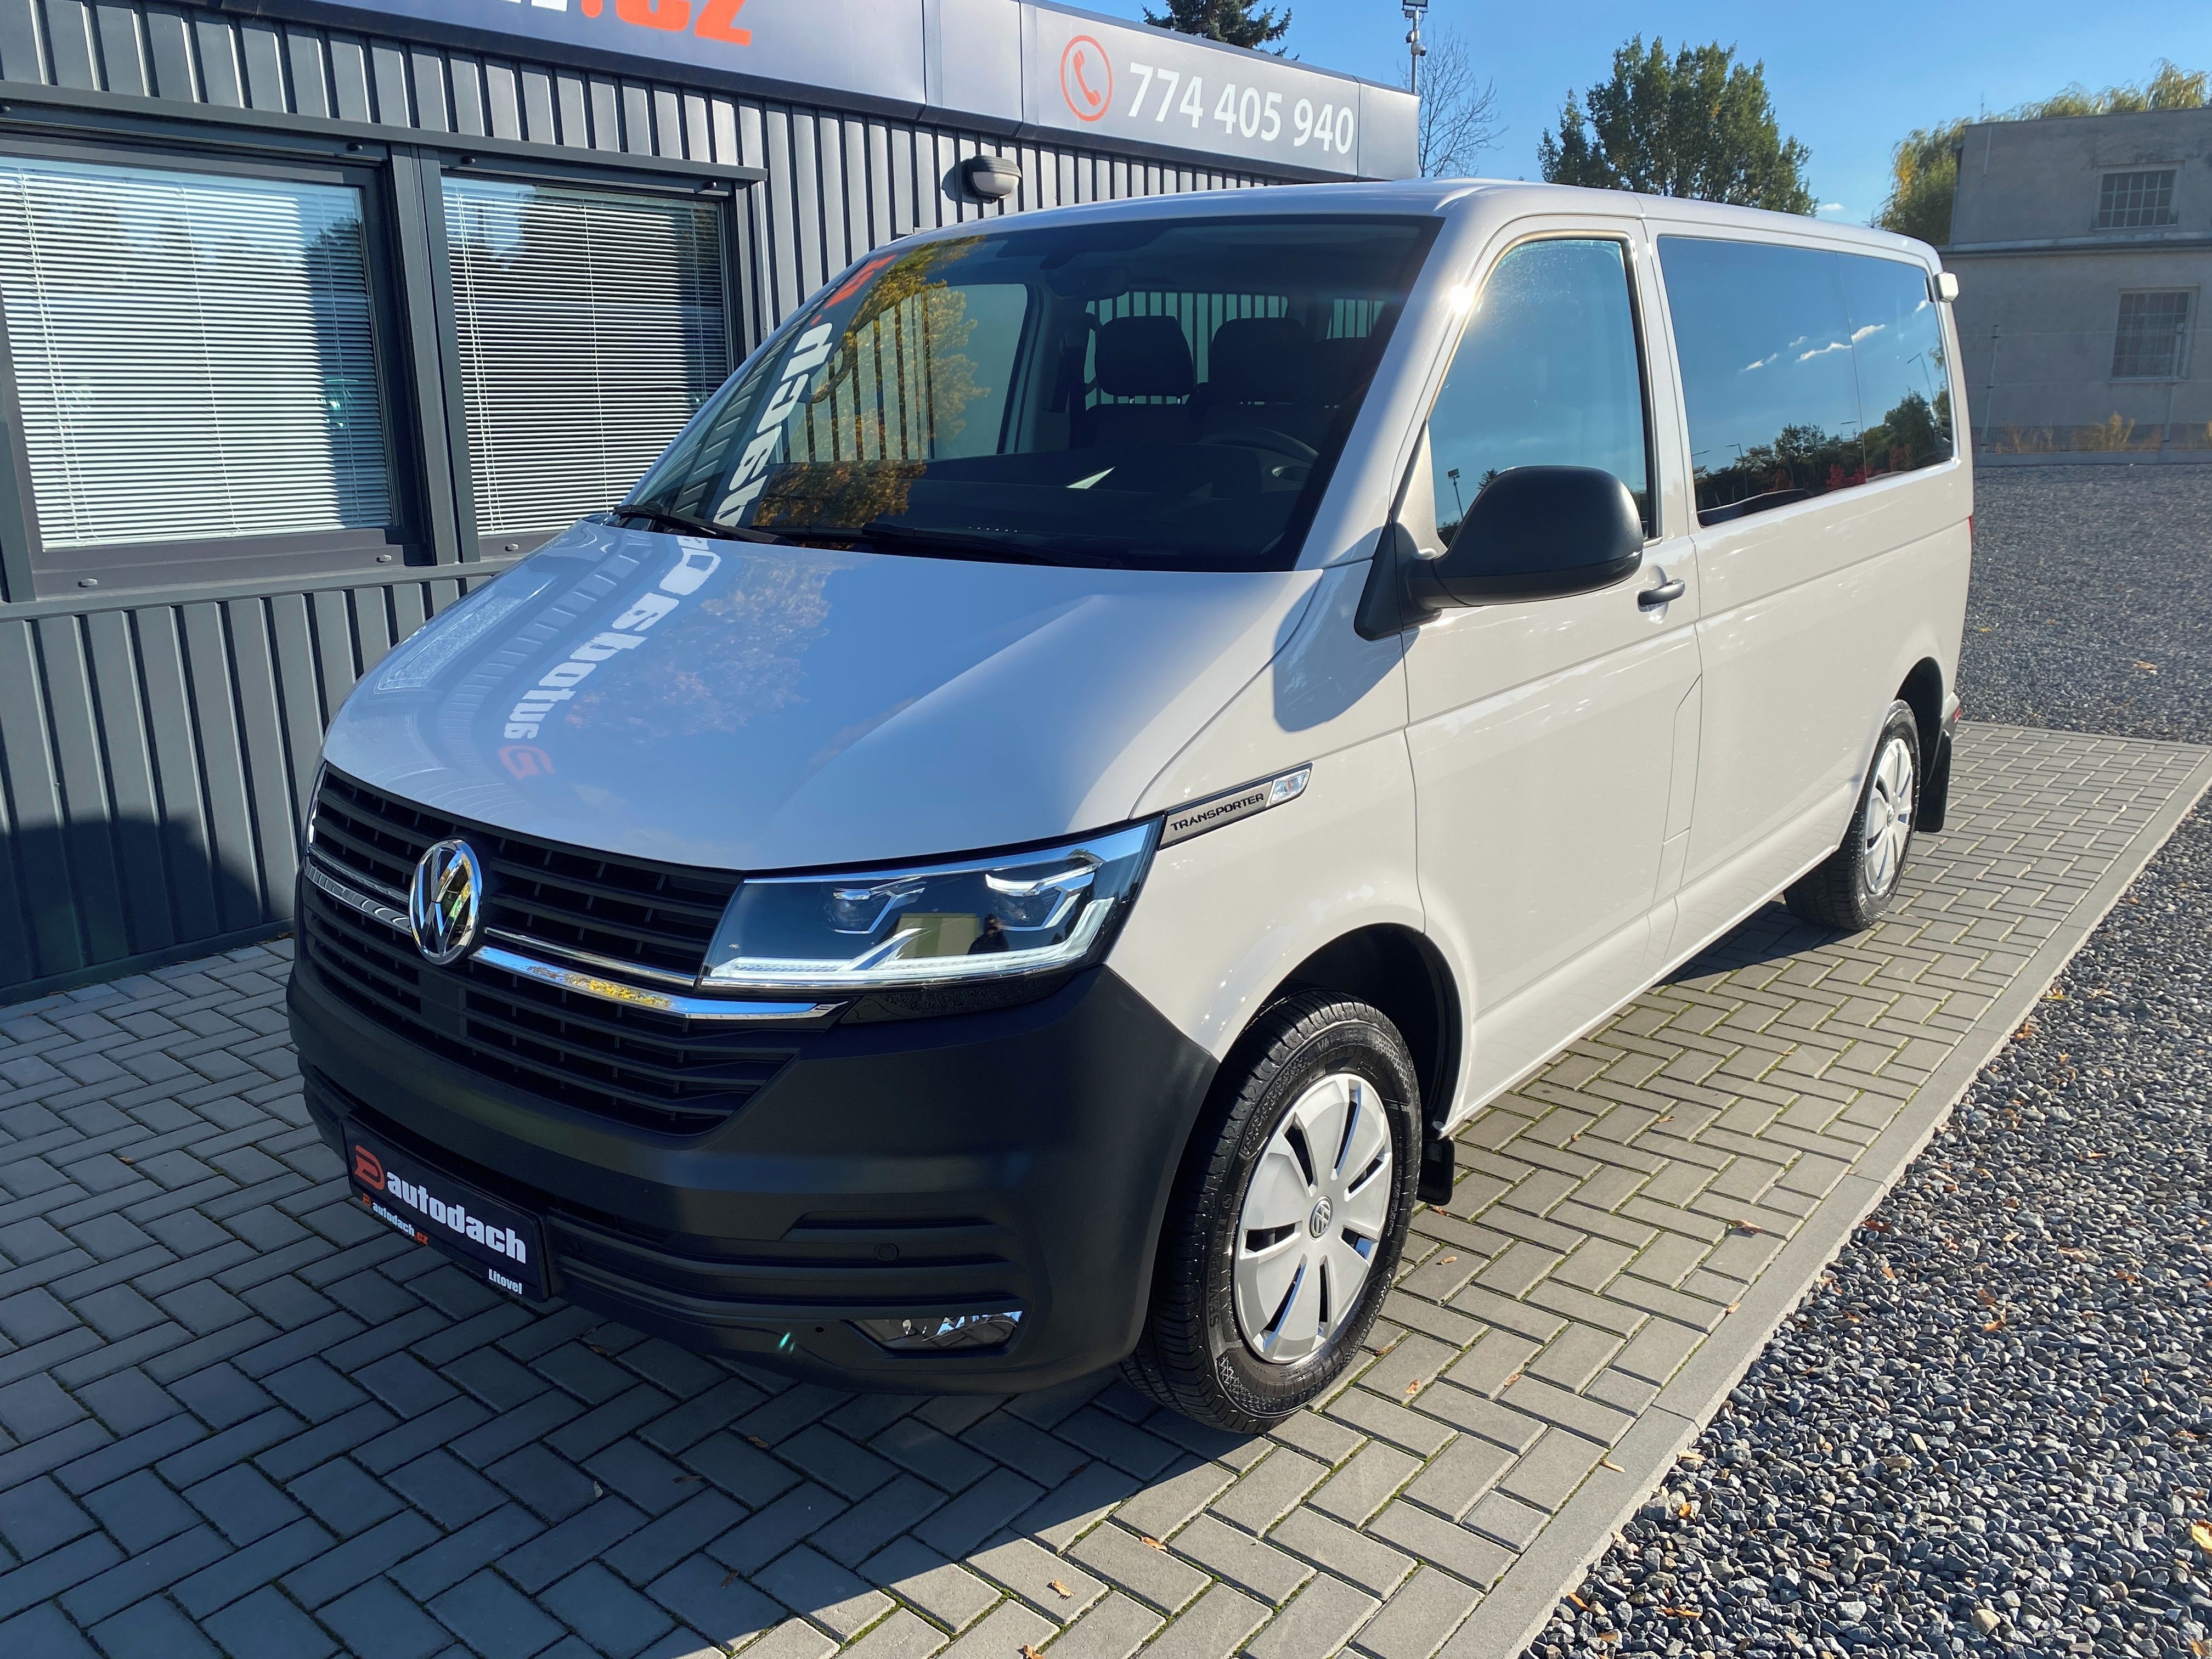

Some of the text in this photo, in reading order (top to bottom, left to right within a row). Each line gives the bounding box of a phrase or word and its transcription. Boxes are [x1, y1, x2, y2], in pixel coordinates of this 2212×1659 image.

[1128, 62, 1354, 154] 774 405 940
[1170, 793, 1264, 831] TRANSPORTER
[386, 1171, 526, 1264] autodach
[488, 1268, 523, 1295] Litovel
